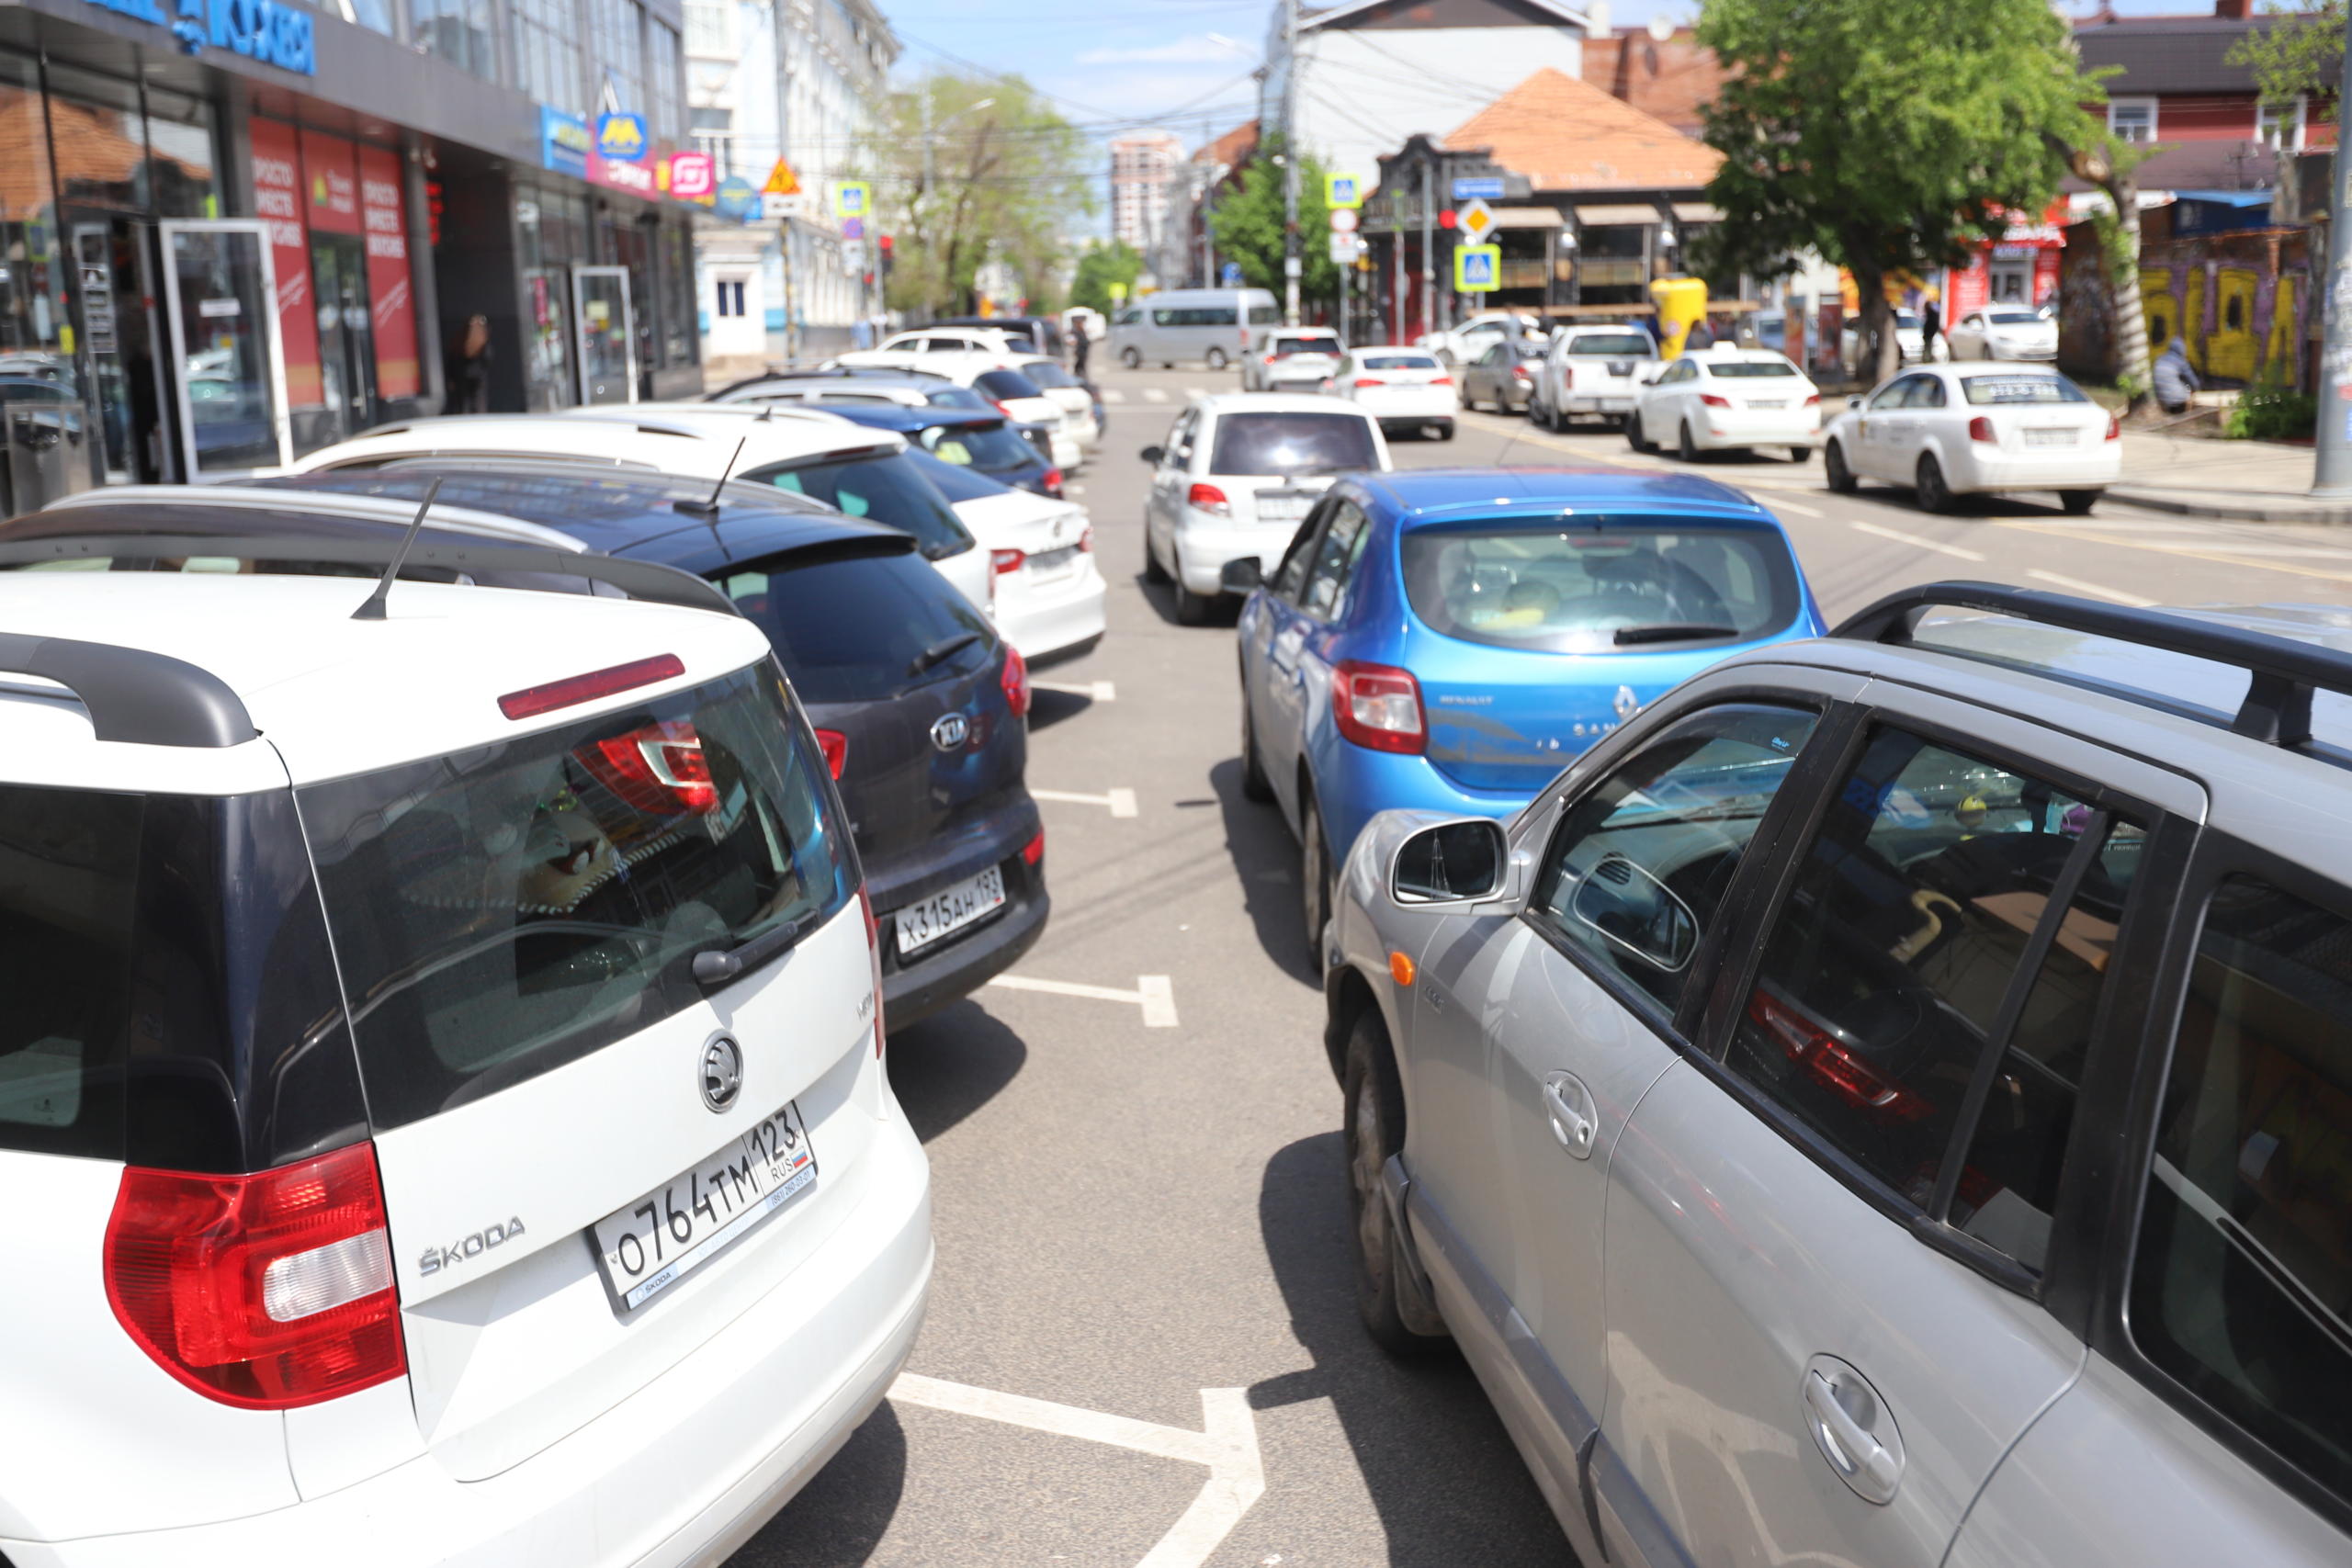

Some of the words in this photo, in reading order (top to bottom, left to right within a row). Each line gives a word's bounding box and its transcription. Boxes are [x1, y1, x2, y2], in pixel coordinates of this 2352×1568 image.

[1440, 694, 1495, 706] RENAULT
[940, 719, 965, 746] KIA
[752, 1110, 797, 1167] 123
[771, 1157, 794, 1183] RUS
[419, 1215, 526, 1278] ŠKODA
